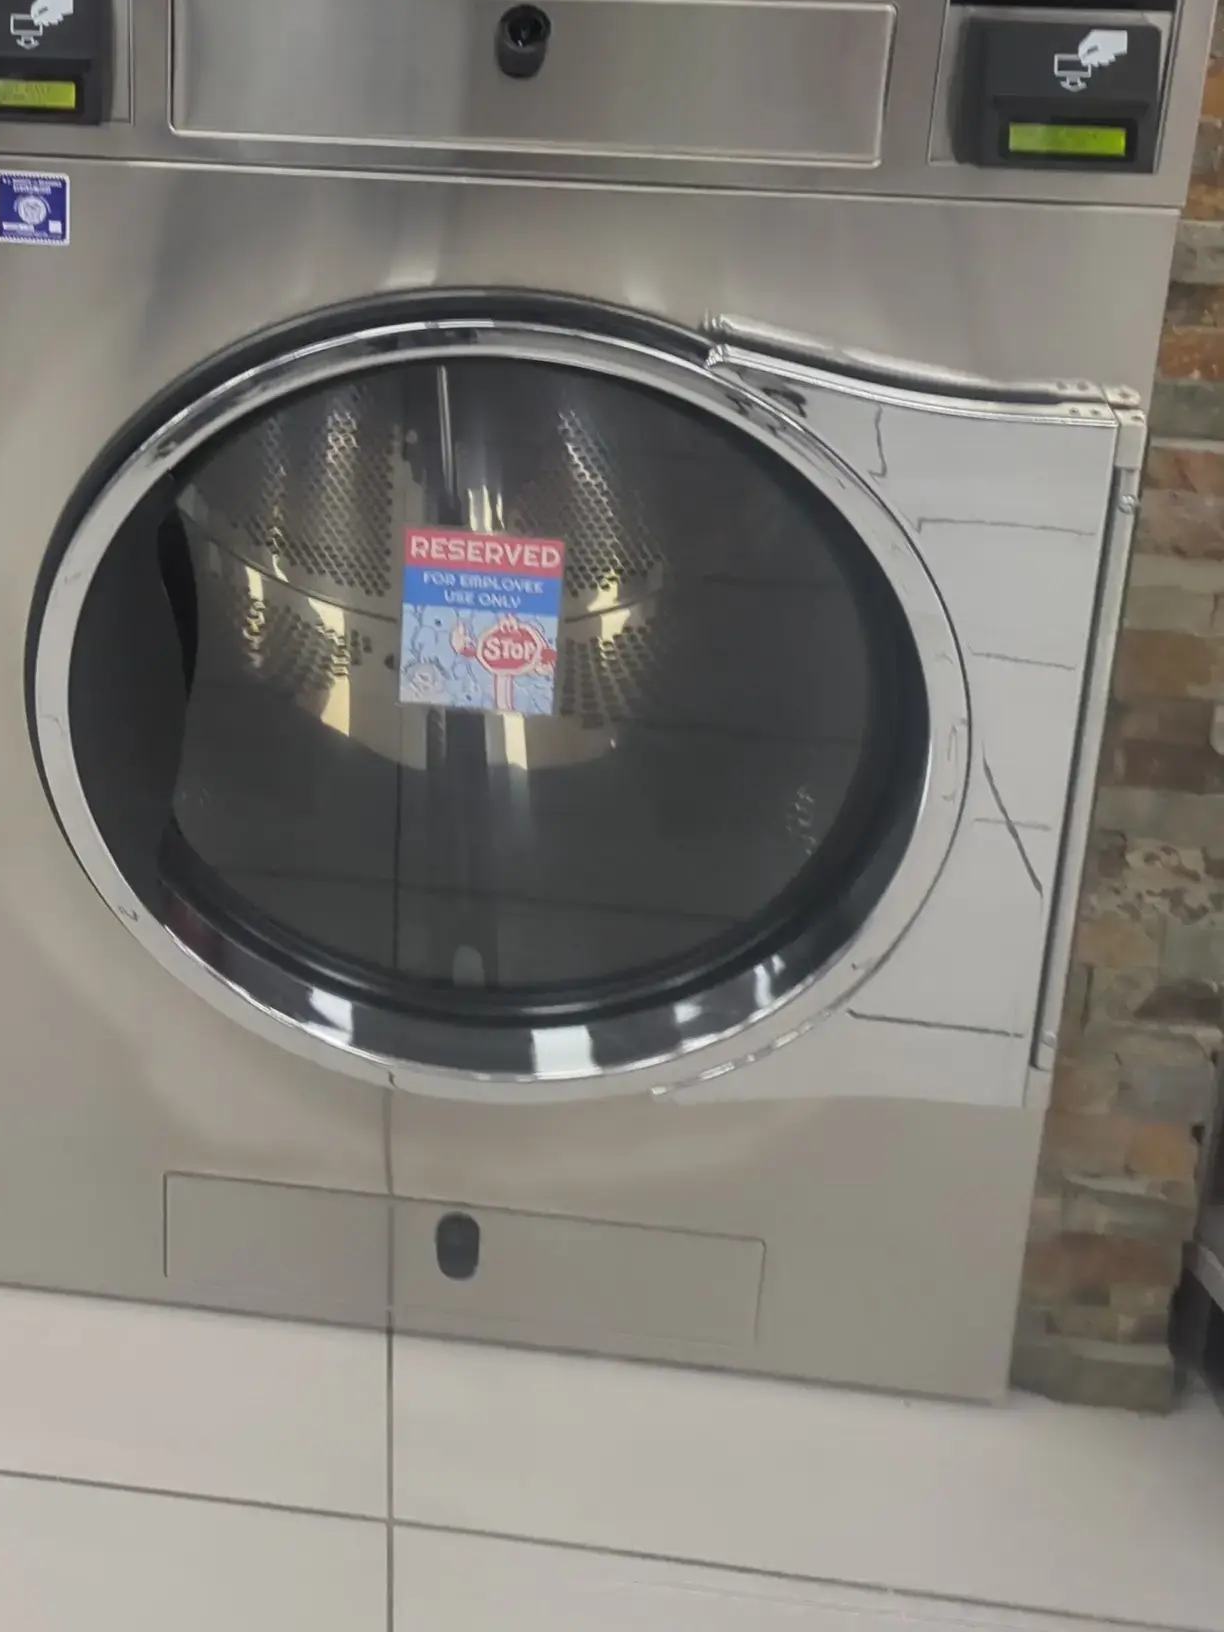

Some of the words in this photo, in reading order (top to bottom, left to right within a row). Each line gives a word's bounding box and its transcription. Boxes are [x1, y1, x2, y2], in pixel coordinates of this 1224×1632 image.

[410, 535, 561, 568] RESERVED
[423, 571, 456, 585] FOR
[460, 572, 544, 594] EMPLOYEE
[444, 590, 475, 605] USE
[479, 592, 521, 609] ONLY
